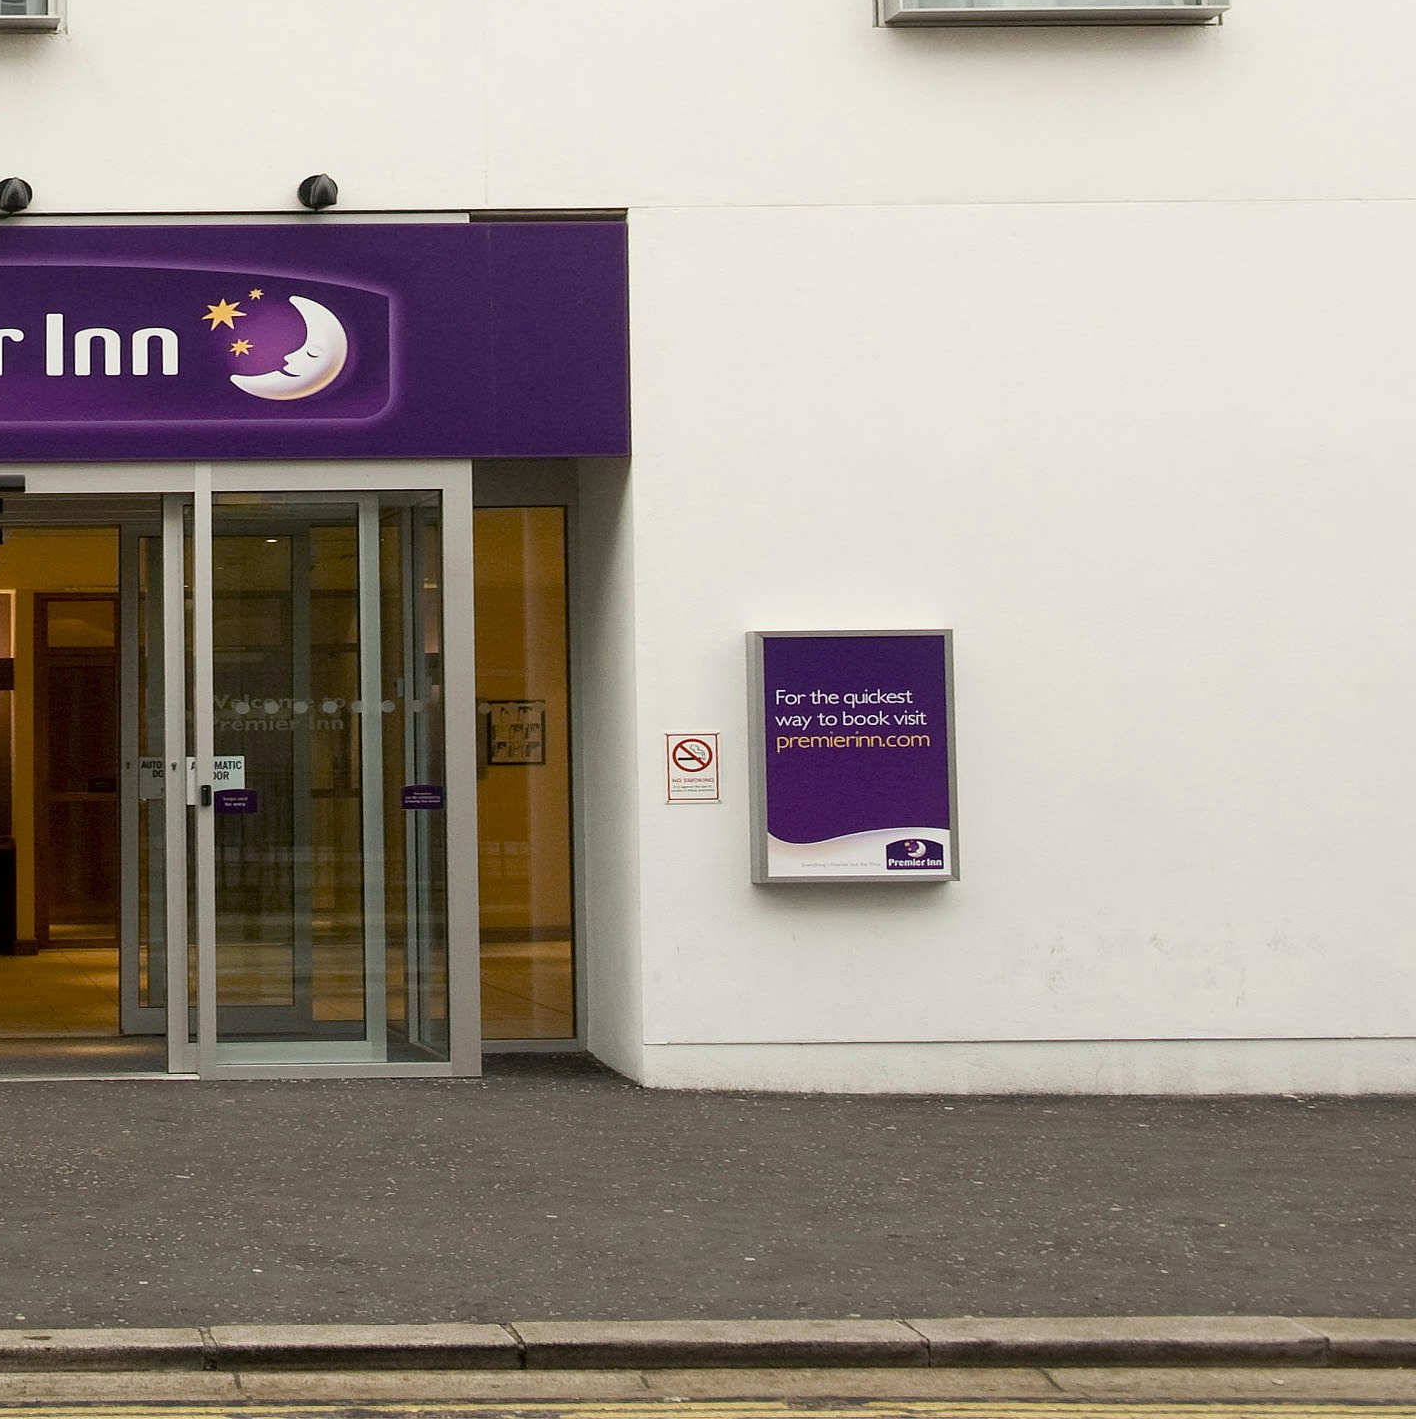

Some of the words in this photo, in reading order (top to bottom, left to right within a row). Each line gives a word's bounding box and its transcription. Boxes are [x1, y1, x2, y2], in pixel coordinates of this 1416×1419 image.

[45, 313, 179, 377] Inn
[776, 689, 806, 705] For
[810, 689, 839, 705] the
[843, 688, 913, 708] quickest
[775, 715, 812, 731] way
[817, 713, 838, 726] to
[842, 710, 890, 726] book
[893, 710, 927, 725] visit
[776, 731, 931, 753] premierinn.com
[888, 858, 926, 867] Premier
[926, 858, 942, 866] Inn
